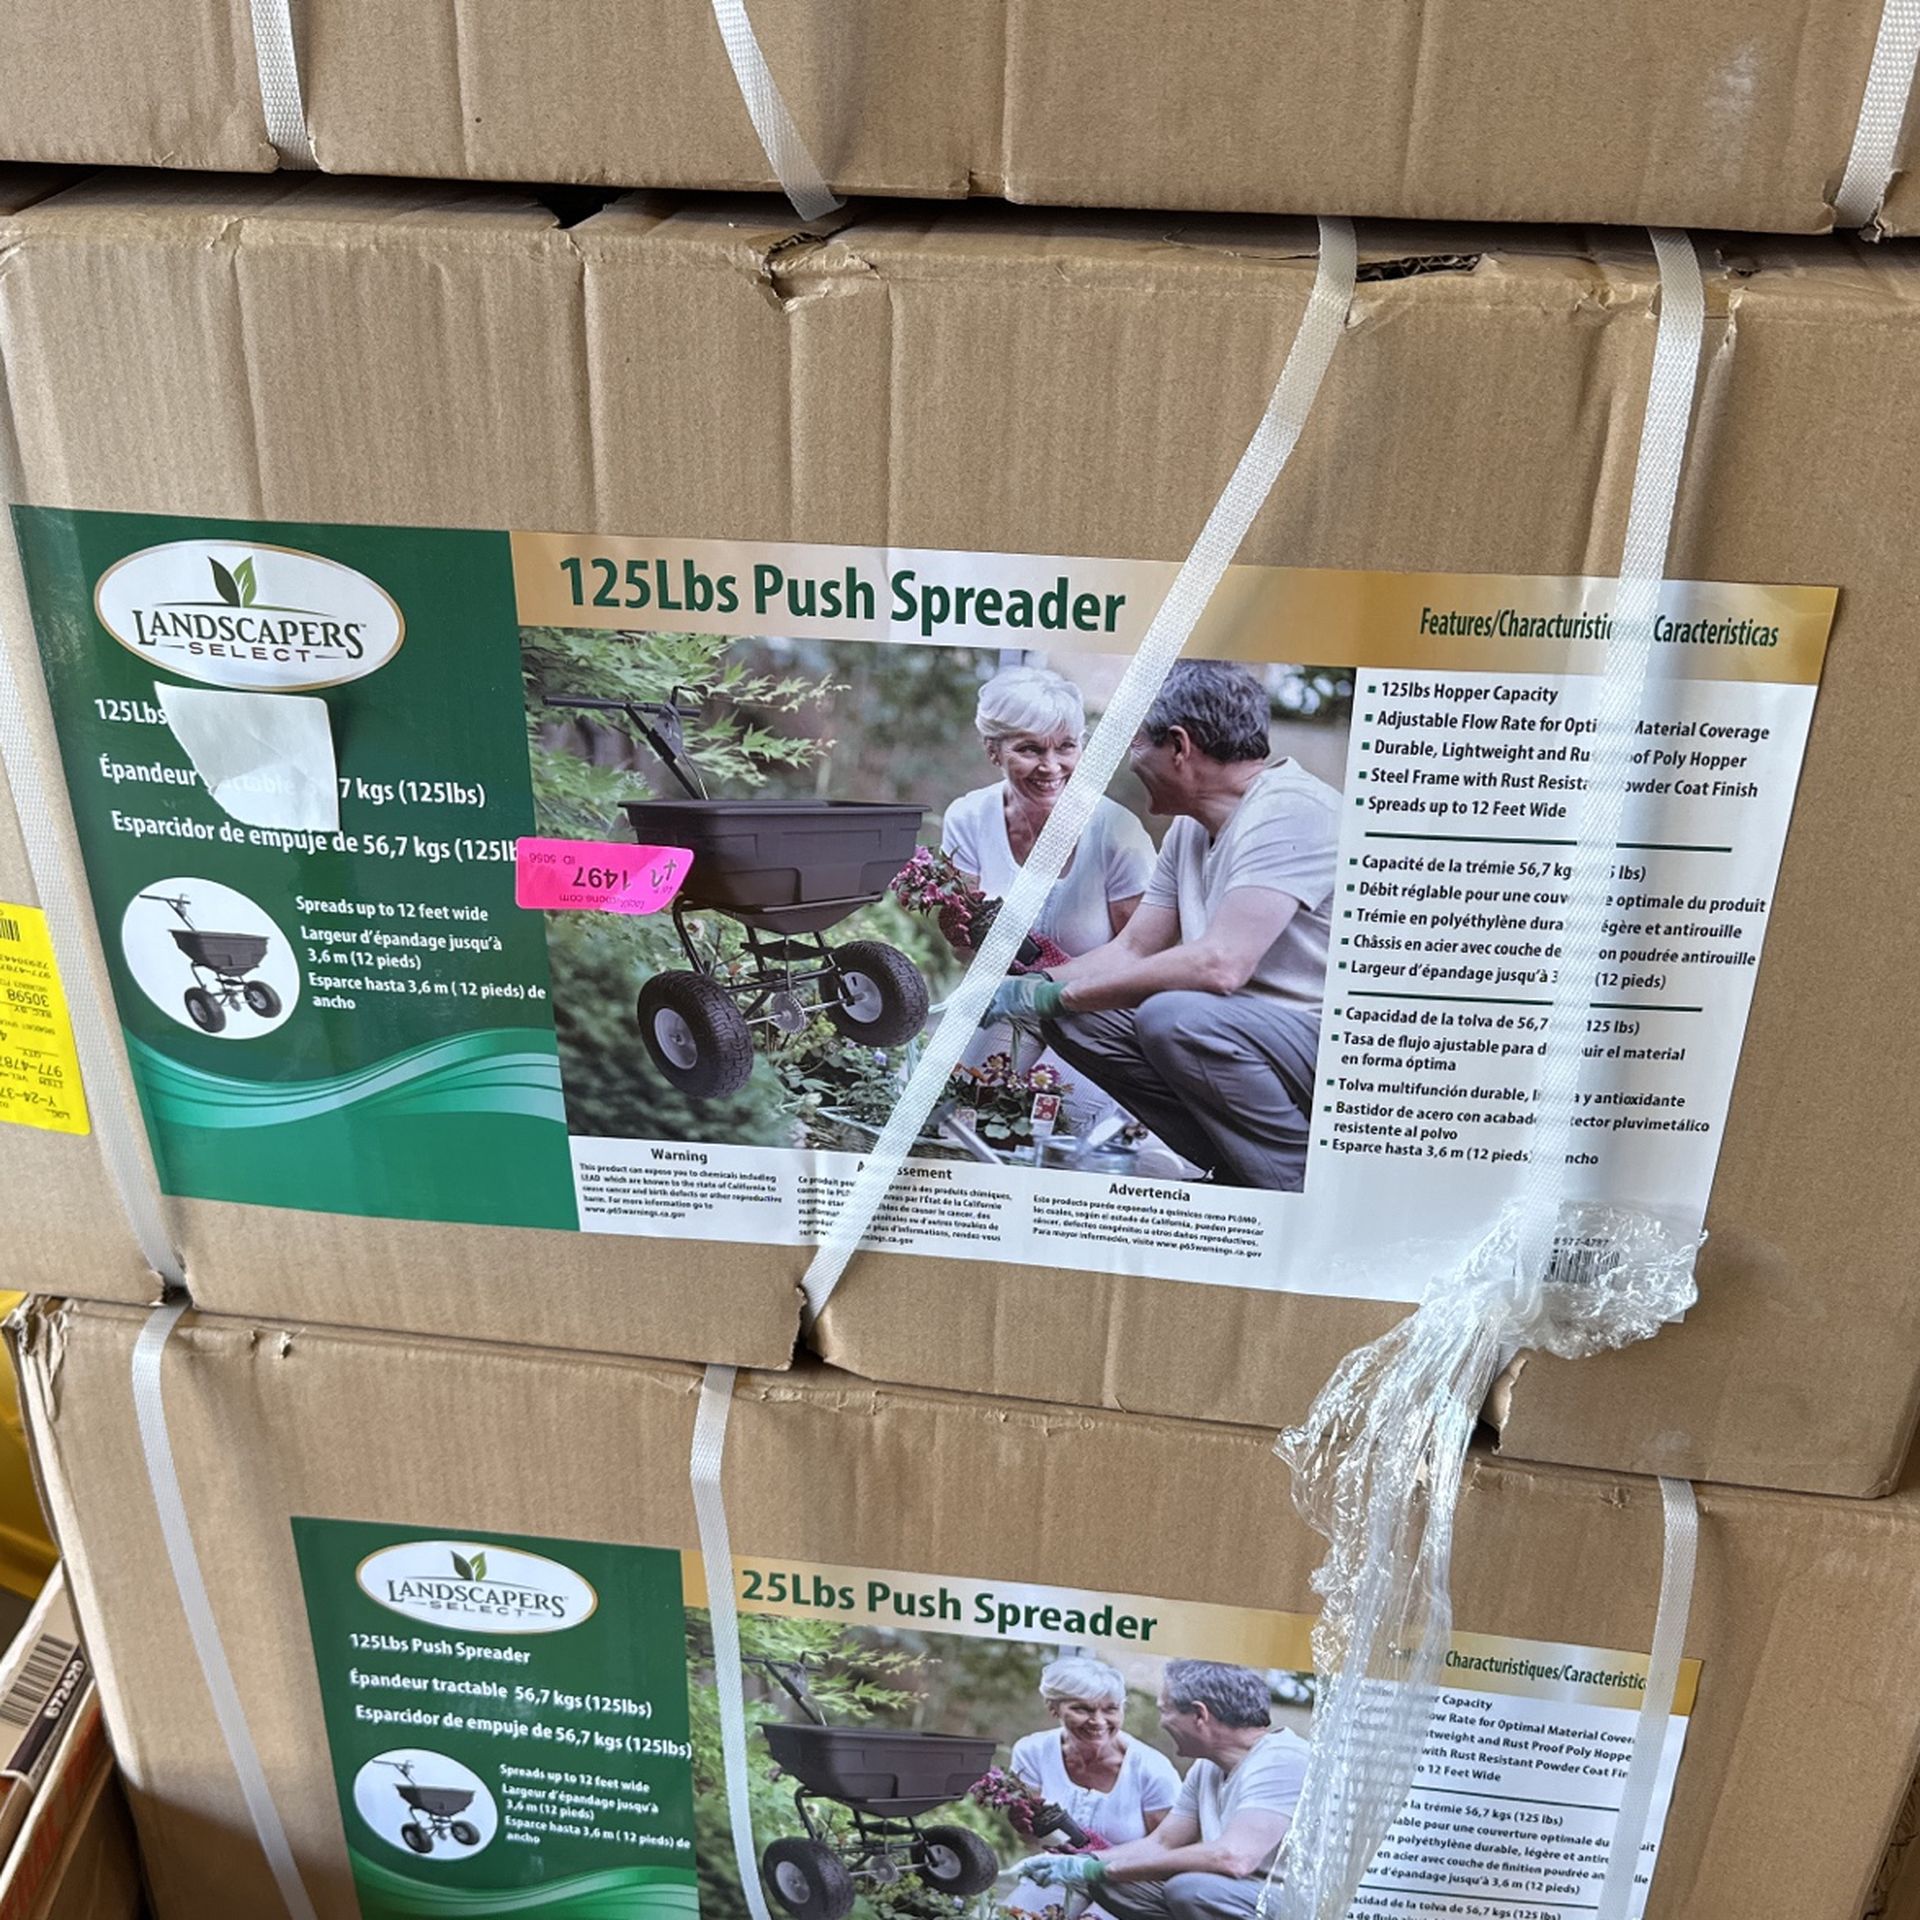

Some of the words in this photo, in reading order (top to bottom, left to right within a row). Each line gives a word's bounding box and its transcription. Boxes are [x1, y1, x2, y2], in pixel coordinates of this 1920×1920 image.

[560, 558, 738, 612] 125Lbs
[754, 564, 874, 619] Push
[891, 570, 1125, 634] Spreader
[132, 608, 363, 660] LANDSCAPERS
[189, 643, 312, 663] SELECT
[1382, 682, 1429, 697] 125lbs
[1434, 683, 1490, 702] Hopper
[1493, 685, 1558, 705] Capacity
[94, 698, 167, 726] 125Lbs
[1377, 710, 1457, 729] Adjustable
[1462, 713, 1497, 729] Flow
[1501, 715, 1535, 730] Rate
[1540, 716, 1561, 731] for
[1565, 717, 1597, 735] Opti
[1699, 722, 1769, 742] Coverage
[1374, 739, 1437, 758] Durable,
[1442, 742, 1534, 762] Lightweight
[1537, 746, 1566, 760] and
[1570, 746, 1589, 761] Ru
[1653, 750, 1686, 768] Poly
[1690, 751, 1747, 770] Hopper
[98, 753, 198, 786] Épandeur
[356, 777, 393, 804] kgs
[399, 780, 484, 807] (125lbs)
[1371, 767, 1409, 783] Steel
[1412, 769, 1459, 785] Frame
[1463, 772, 1497, 786] with
[1501, 773, 1534, 788] Rust
[1674, 780, 1709, 795] Coat
[1712, 781, 1757, 797] Finish
[1368, 796, 1425, 813] Spreads
[1429, 802, 1448, 816] up
[1452, 801, 1467, 813] to
[1472, 800, 1488, 814] 12
[1493, 801, 1525, 816] Feet
[1530, 802, 1566, 817] Wide
[111, 809, 215, 841] Esparcidor
[219, 821, 245, 843] de
[249, 828, 327, 855] empuje
[332, 828, 357, 851] de
[363, 834, 407, 858] 56,7
[413, 836, 450, 862] kgs
[572, 866, 631, 890] 1497
[1362, 854, 1423, 872] Capacité
[1427, 858, 1444, 871] de
[1448, 858, 1461, 872] la
[1466, 860, 1514, 874] trémie
[1518, 862, 1550, 877] 56,7
[1553, 862, 1571, 880] kg
[1619, 865, 1645, 882] lbs)
[296, 895, 354, 914] Spreads
[356, 903, 375, 918] up
[378, 903, 394, 916] to
[397, 903, 415, 917] 12
[418, 903, 449, 919] feet
[452, 906, 487, 921] wide
[1359, 881, 1398, 896] Débit
[1401, 884, 1461, 901] réglable
[1465, 890, 1499, 903] pour
[1502, 892, 1530, 902] une
[1616, 894, 1683, 910] optimale
[1687, 896, 1706, 909] du
[1709, 897, 1765, 913] produit
[300, 925, 356, 944] Largeur
[1357, 908, 1406, 923] Trémie
[1409, 914, 1427, 924] en
[1430, 912, 1526, 930] polyéthylène
[1645, 923, 1661, 935] et
[1663, 923, 1741, 938] antirouille
[308, 948, 330, 963] 3,6
[333, 953, 347, 963] m
[350, 951, 373, 966] (12
[376, 953, 420, 969] pieds)
[308, 972, 362, 990] Esparce
[364, 976, 405, 992] hasta
[408, 980, 430, 994] 3,6
[434, 984, 448, 993] m
[459, 982, 477, 995] 12
[481, 983, 524, 999] pieds)
[527, 984, 545, 998] de
[1351, 960, 1405, 977] Largeur
[1595, 972, 1618, 986] (12
[1620, 973, 1665, 990] pieds)
[313, 995, 355, 1008] ancho
[1346, 1007, 1417, 1023] Capacidad
[1420, 1011, 1437, 1024] de
[1441, 1012, 1453, 1025] la
[1458, 1014, 1492, 1027] tolva
[1496, 1015, 1513, 1028] de
[1517, 1017, 1548, 1031] 56,7
[1587, 1019, 1610, 1033] 125
[1614, 1020, 1639, 1035] lbs)
[1341, 1055, 1358, 1064] en
[1362, 1053, 1402, 1067] forma
[1405, 1056, 1455, 1071] óptima
[1334, 1122, 1402, 1136] resistente
[1404, 1125, 1417, 1137] al
[1420, 1127, 1457, 1140] polvo
[651, 1148, 707, 1164] Warning
[1109, 1183, 1189, 1201] Advertencia
[388, 1579, 566, 1618] LANDSCAPERS
[429, 1599, 525, 1617] SELECT
[868, 1581, 960, 1620] Push
[974, 1593, 1157, 1640] Spreader
[350, 1633, 408, 1651] 125Lbs
[411, 1638, 452, 1654] Push
[455, 1642, 530, 1662] Spreader
[350, 1668, 428, 1690] Épandeur
[432, 1678, 507, 1698] tractable
[515, 1686, 549, 1704] 56,7
[553, 1689, 582, 1709] kgs
[585, 1694, 651, 1718] (125lbs)
[1442, 1694, 1492, 1711] Capacity
[356, 1704, 439, 1725] Esparcidor
[442, 1712, 463, 1727] de
[466, 1718, 528, 1737] empuje
[532, 1722, 552, 1738] de
[555, 1727, 590, 1745] 56,7
[594, 1731, 622, 1751] kgs
[625, 1735, 692, 1759] (125lbs)
[1449, 1713, 1476, 1725] Rate
[1479, 1716, 1495, 1727] for
[1498, 1719, 1545, 1733] Optimal
[1547, 1725, 1598, 1740] Material
[1421, 1747, 1446, 1757] with
[1450, 1748, 1475, 1760] Rust
[1478, 1752, 1533, 1768] Resistant
[1535, 1759, 1580, 1772] Powder
[1582, 1765, 1608, 1776] Coat
[1428, 1764, 1441, 1774] 12
[1444, 1766, 1469, 1777] Feet
[1472, 1769, 1500, 1781] Wide
